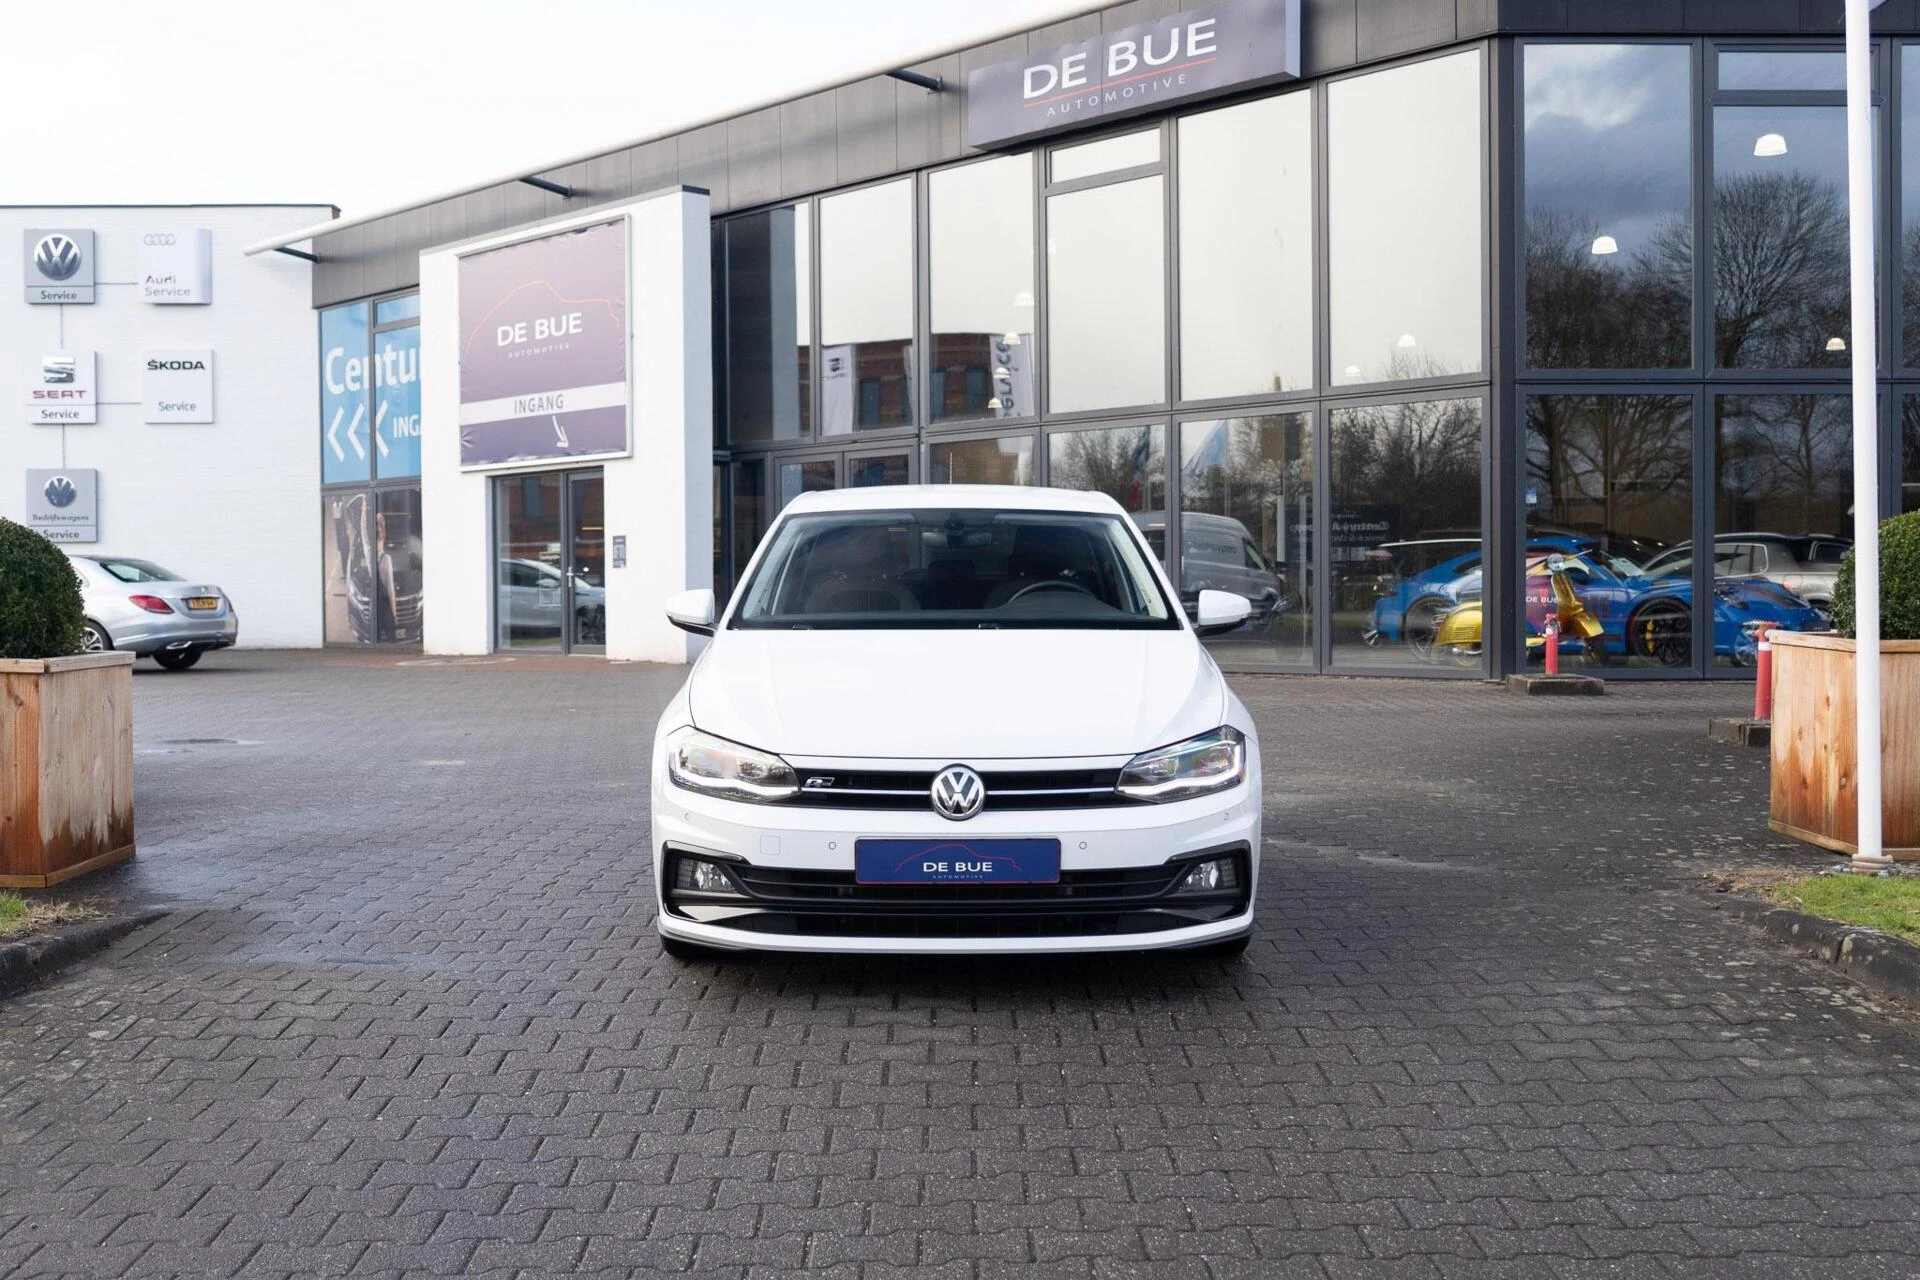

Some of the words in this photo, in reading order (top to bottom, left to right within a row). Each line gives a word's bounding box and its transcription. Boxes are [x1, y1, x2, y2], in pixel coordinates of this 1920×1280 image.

[1023, 52, 1087, 99] DE
[1108, 18, 1217, 77] BUE
[1046, 74, 1188, 117] AUTOMOTIVE
[145, 275, 176, 285] Audi
[41, 290, 77, 300] Service
[145, 286, 191, 297] Service
[497, 322, 528, 347] DE
[535, 312, 583, 341] BUE
[508, 343, 570, 358] AUTOMOTIVE
[147, 359, 205, 371] ŠKODA
[325, 343, 422, 394] Centu
[32, 390, 87, 399] SEAT
[158, 401, 196, 411] Service
[514, 394, 565, 415] INGANG
[41, 409, 79, 419] Service
[393, 413, 421, 439] ING
[43, 529, 80, 538] Service
[923, 861, 948, 872] DE
[955, 861, 992, 872] BUE
